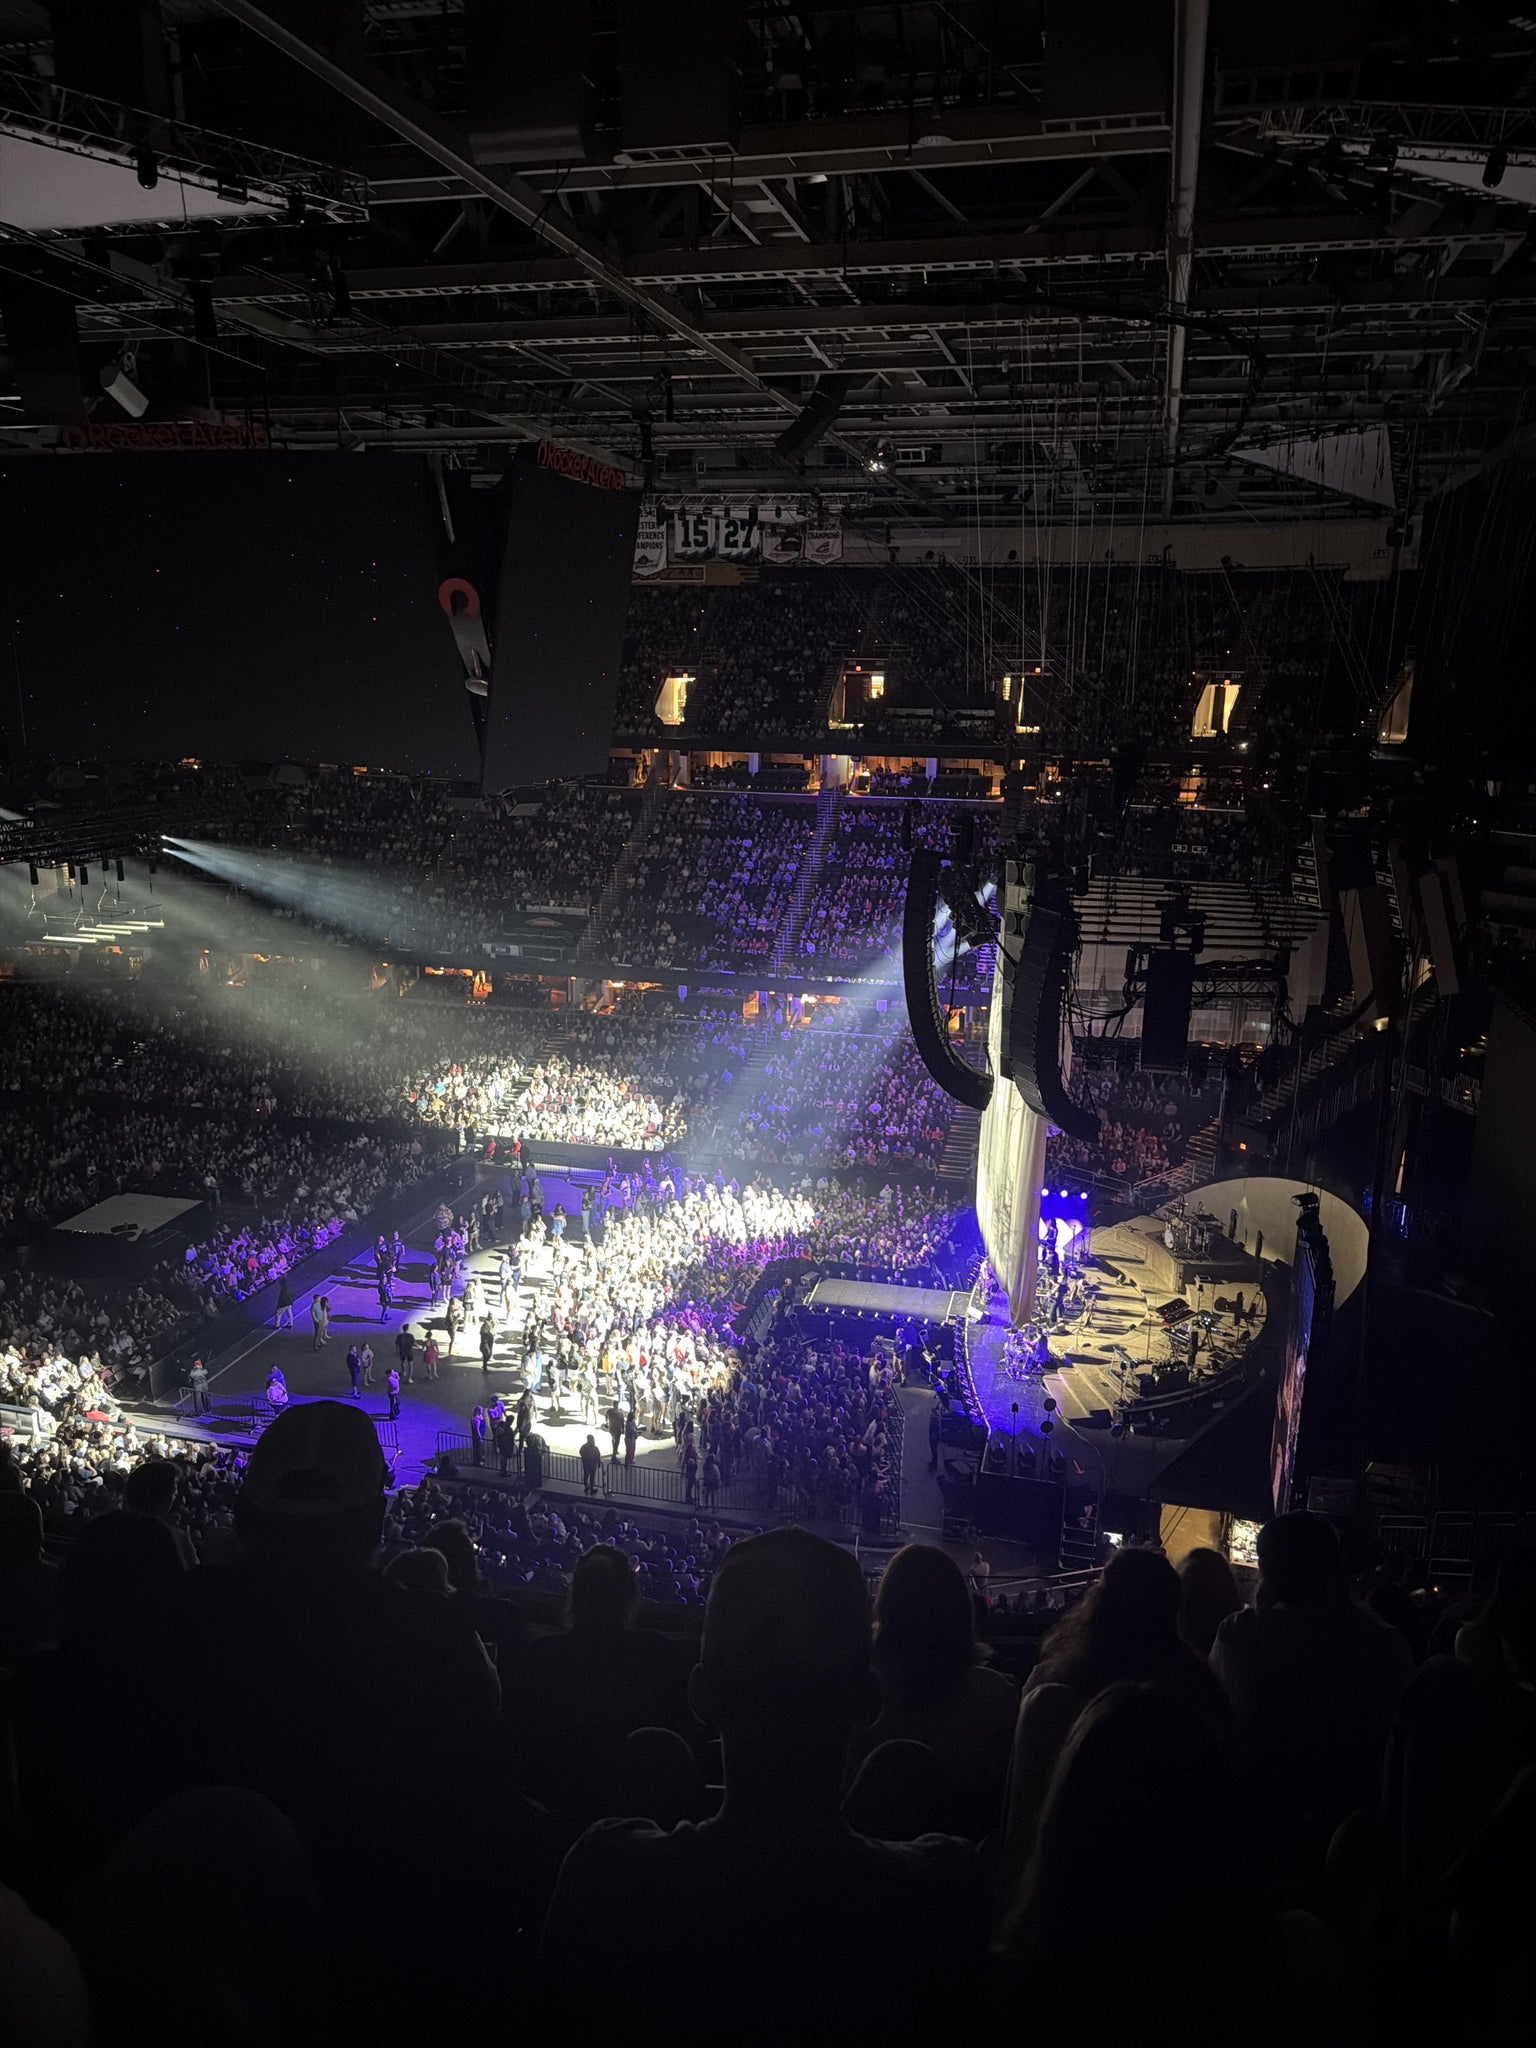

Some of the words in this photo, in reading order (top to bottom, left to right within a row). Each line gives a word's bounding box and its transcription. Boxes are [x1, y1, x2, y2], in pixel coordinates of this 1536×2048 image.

[88, 423, 187, 447] Rocket
[192, 422, 271, 448] Arena
[546, 442, 587, 479] Rocket
[589, 460, 625, 490] Arena
[682, 519, 709, 547] 15
[724, 518, 755, 548] 27
[807, 531, 840, 540] CHAMPIONS
